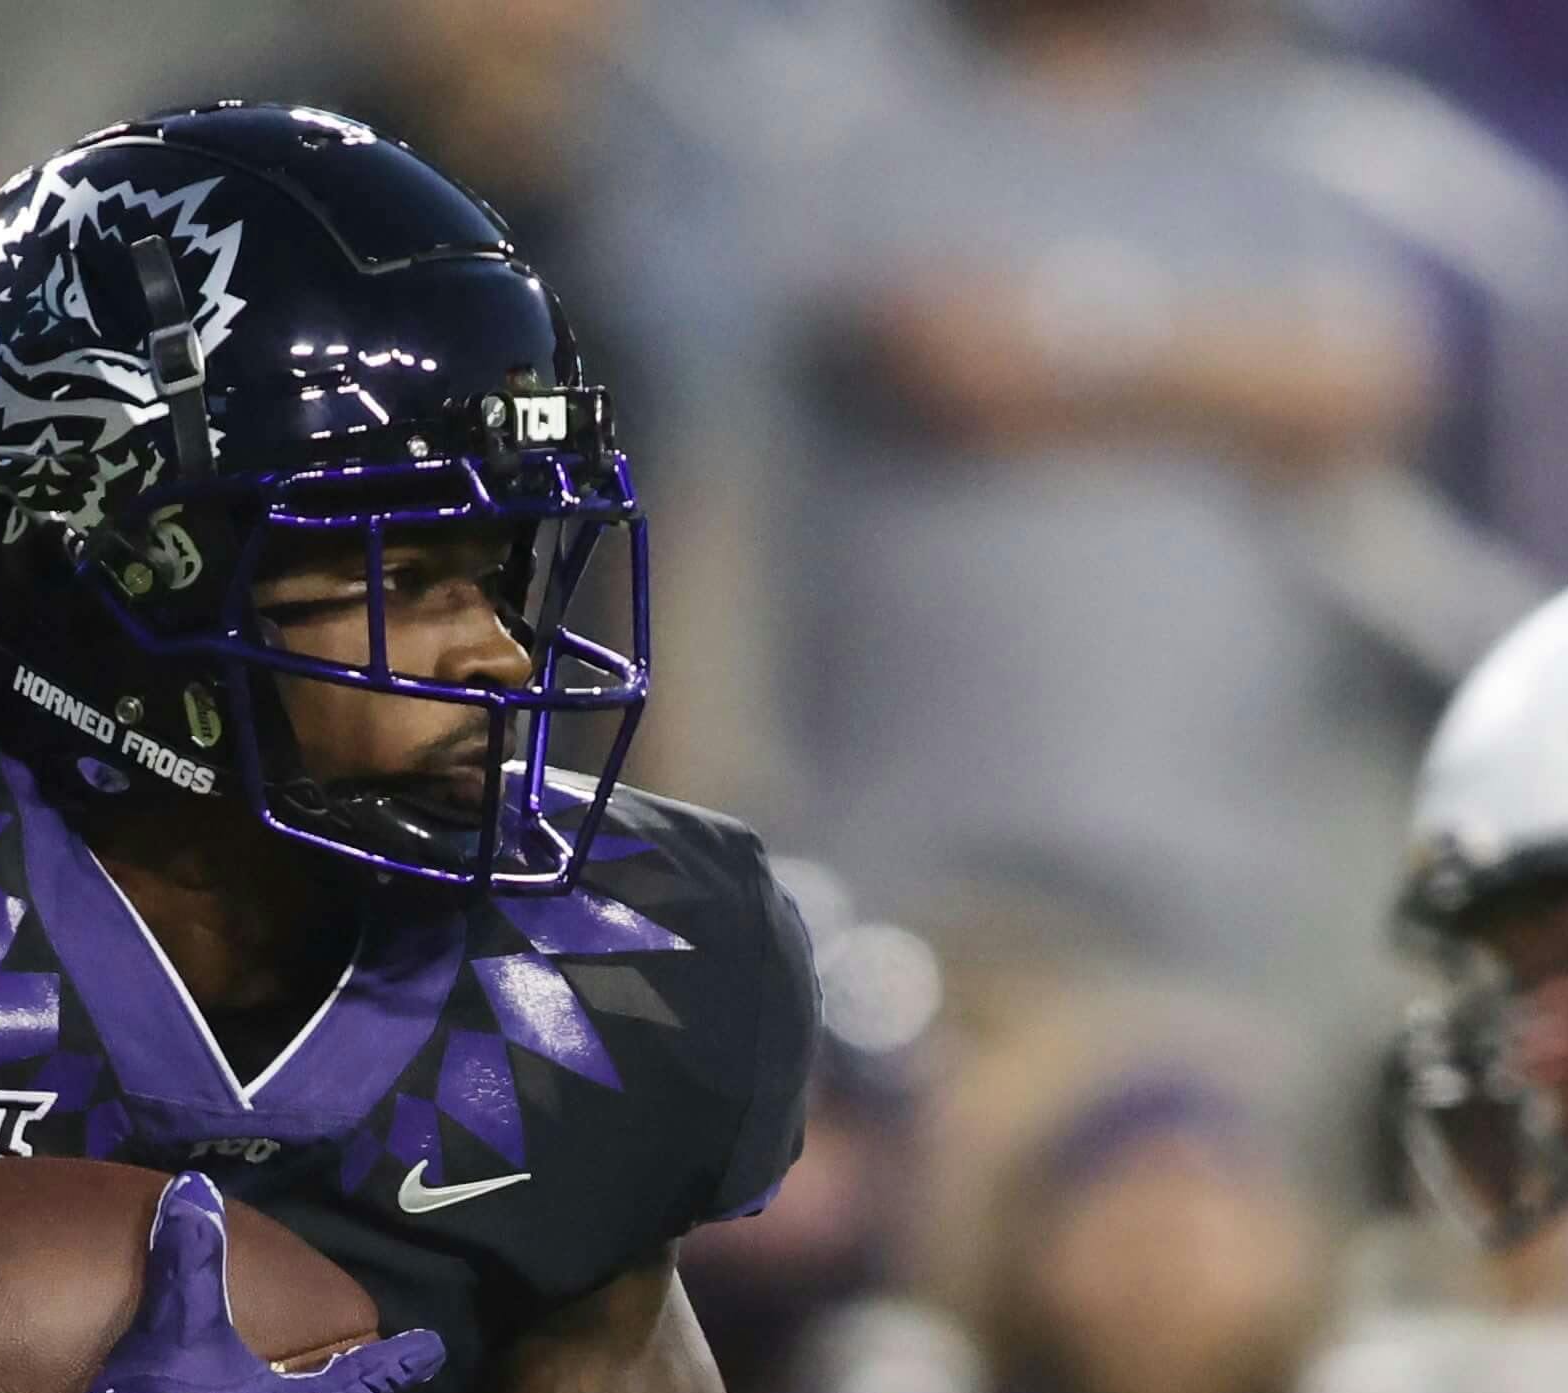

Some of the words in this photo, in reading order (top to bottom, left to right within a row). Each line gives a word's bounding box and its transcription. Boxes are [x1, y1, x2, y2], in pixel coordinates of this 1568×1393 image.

[513, 396, 567, 441] TCU
[13, 665, 116, 744] HORNED
[121, 730, 216, 794] FROGS
